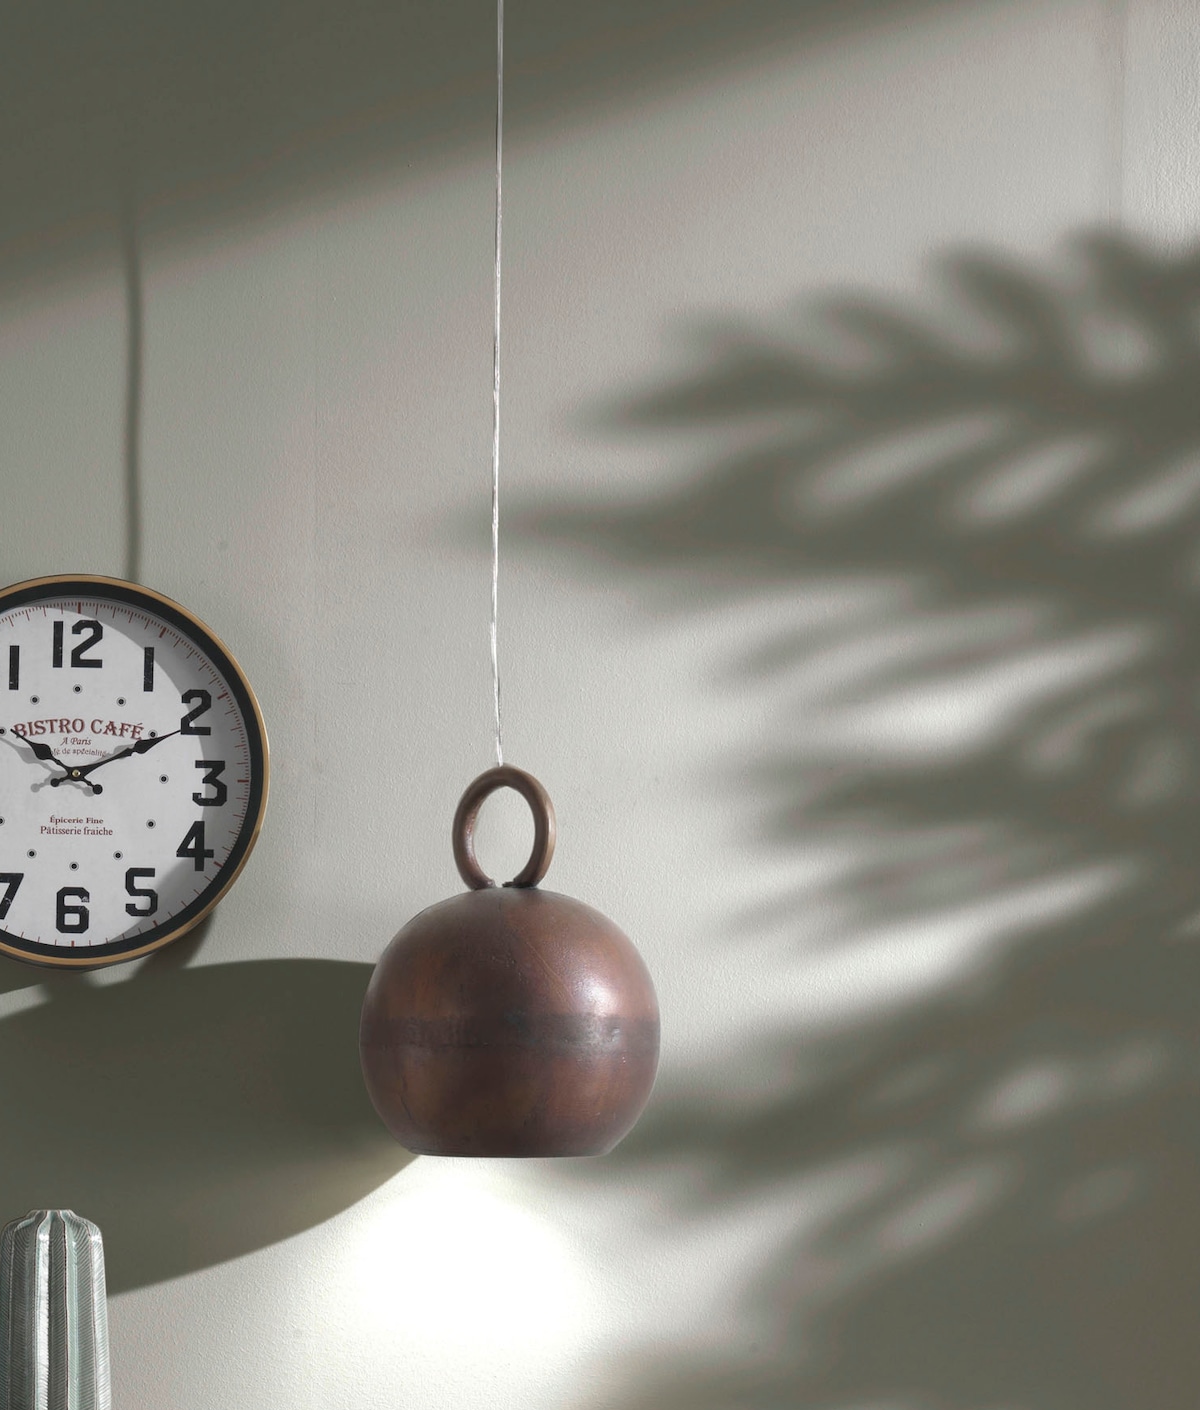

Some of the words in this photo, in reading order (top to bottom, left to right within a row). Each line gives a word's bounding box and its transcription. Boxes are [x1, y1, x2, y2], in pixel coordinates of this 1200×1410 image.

[52, 620, 103, 668] 12
[143, 647, 155, 692] 1
[13, 718, 85, 739] BISTRO
[90, 719, 145, 740] CAFÉ
[180, 689, 212, 736] 2
[61, 747, 71, 755] de
[70, 736, 92, 746] Paris
[192, 760, 227, 806] 3
[40, 825, 82, 835] Pâtisserie
[49, 815, 84, 825] Épicerie
[176, 821, 214, 872] 4
[56, 886, 90, 934] 6
[125, 867, 158, 917] 5
